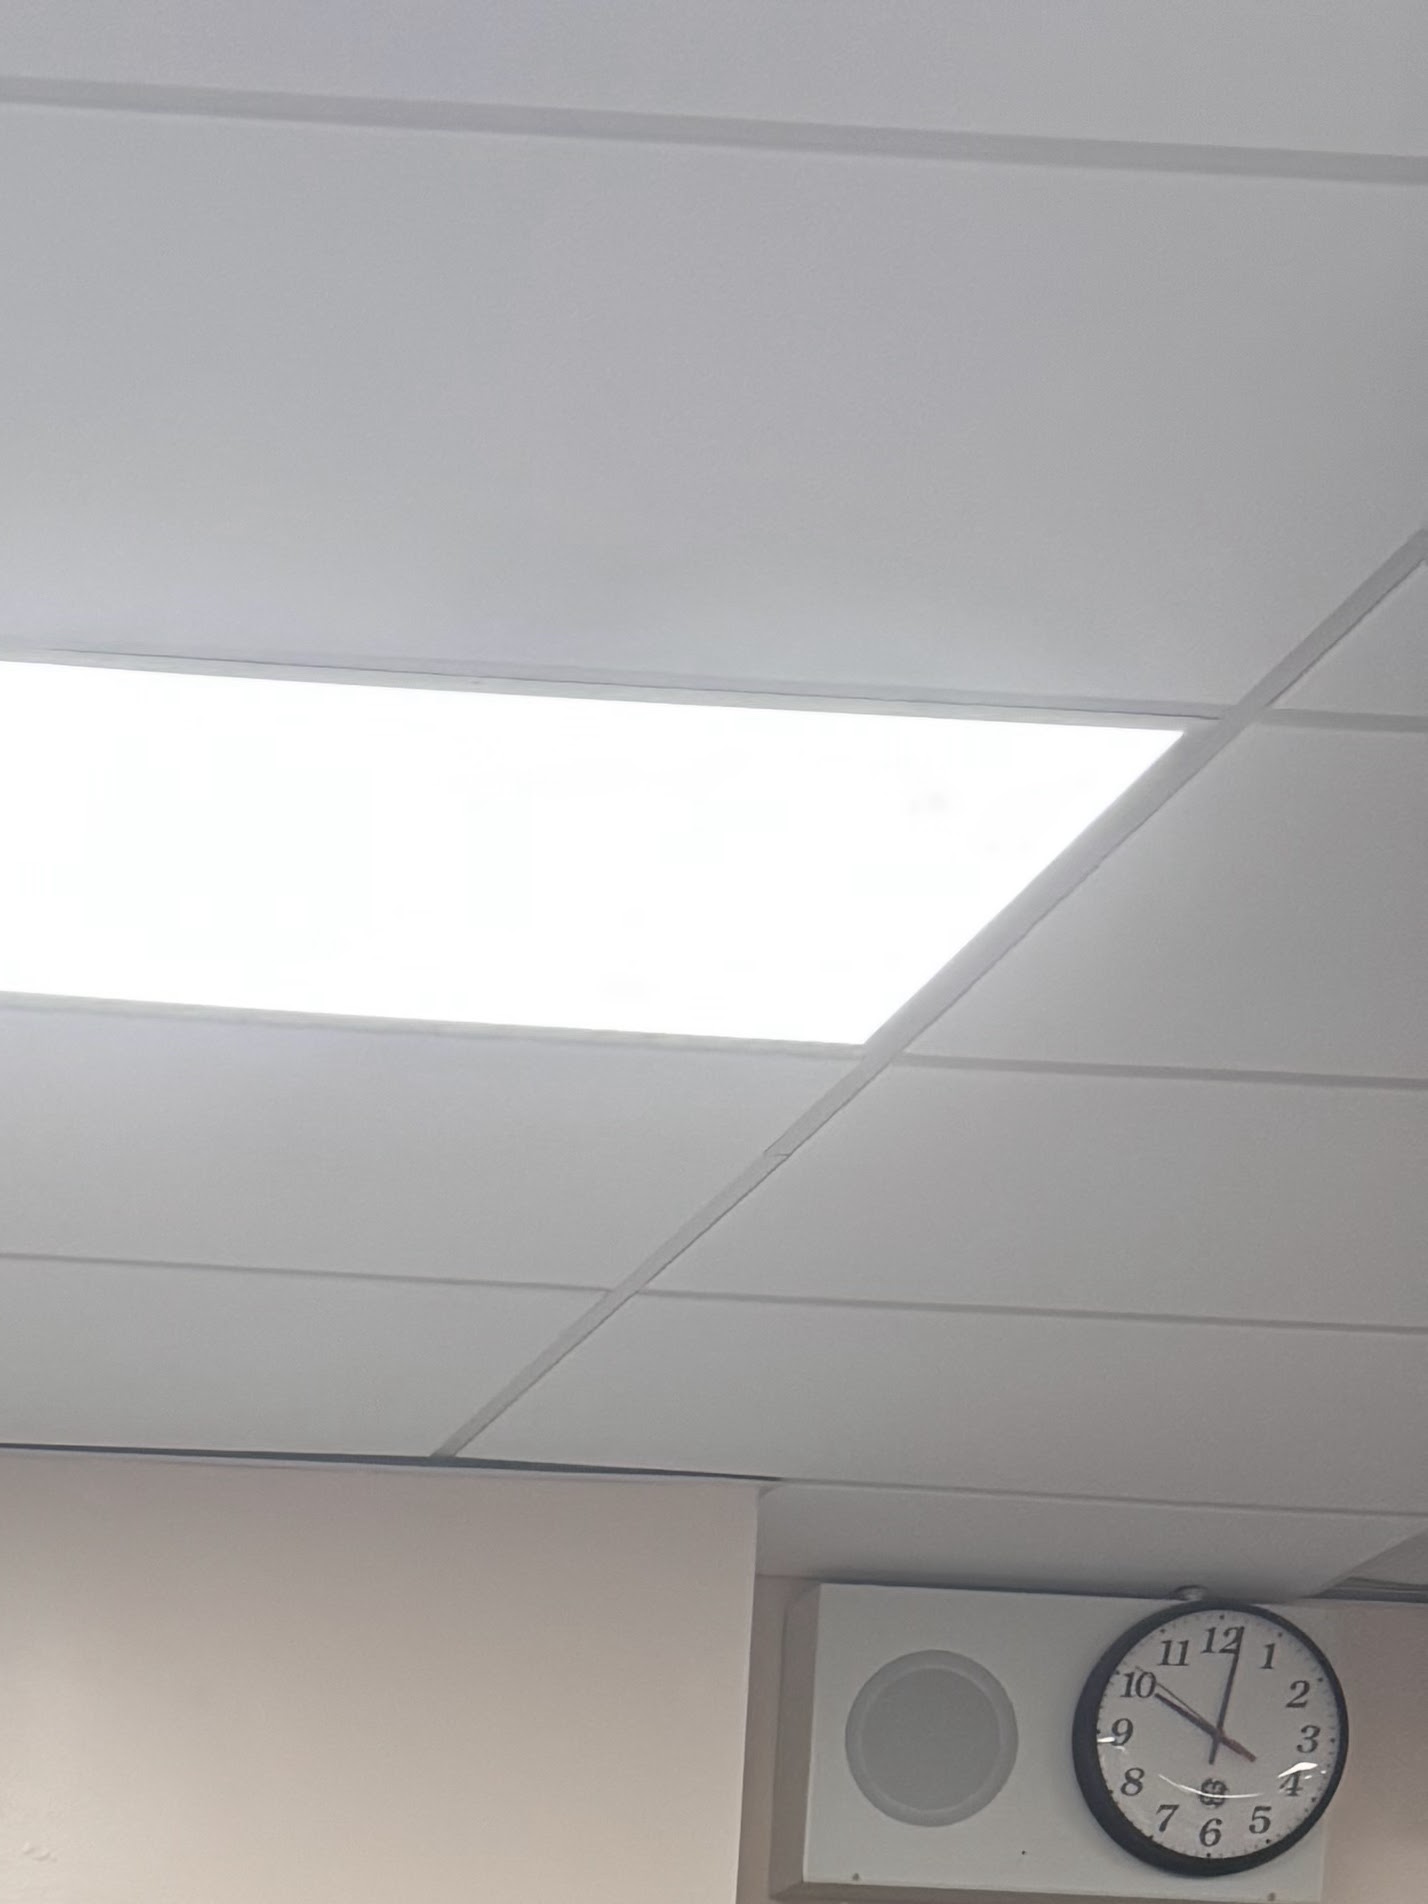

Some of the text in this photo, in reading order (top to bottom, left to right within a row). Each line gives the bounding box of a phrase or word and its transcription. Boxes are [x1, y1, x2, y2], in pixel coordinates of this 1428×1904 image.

[1158, 1640, 1191, 1667] 11
[1202, 1627, 1239, 1654] 12
[1259, 1644, 1278, 1670] 1
[1120, 1671, 1156, 1699] 10
[1285, 1681, 1311, 1709] 2
[1111, 1718, 1134, 1747] 9
[1296, 1725, 1321, 1755] 3
[1120, 1767, 1145, 1796] 8
[1278, 1766, 1306, 1798] 4
[1155, 1805, 1179, 1832] 7
[1248, 1806, 1272, 1835] 5
[1199, 1818, 1222, 1848] 6
